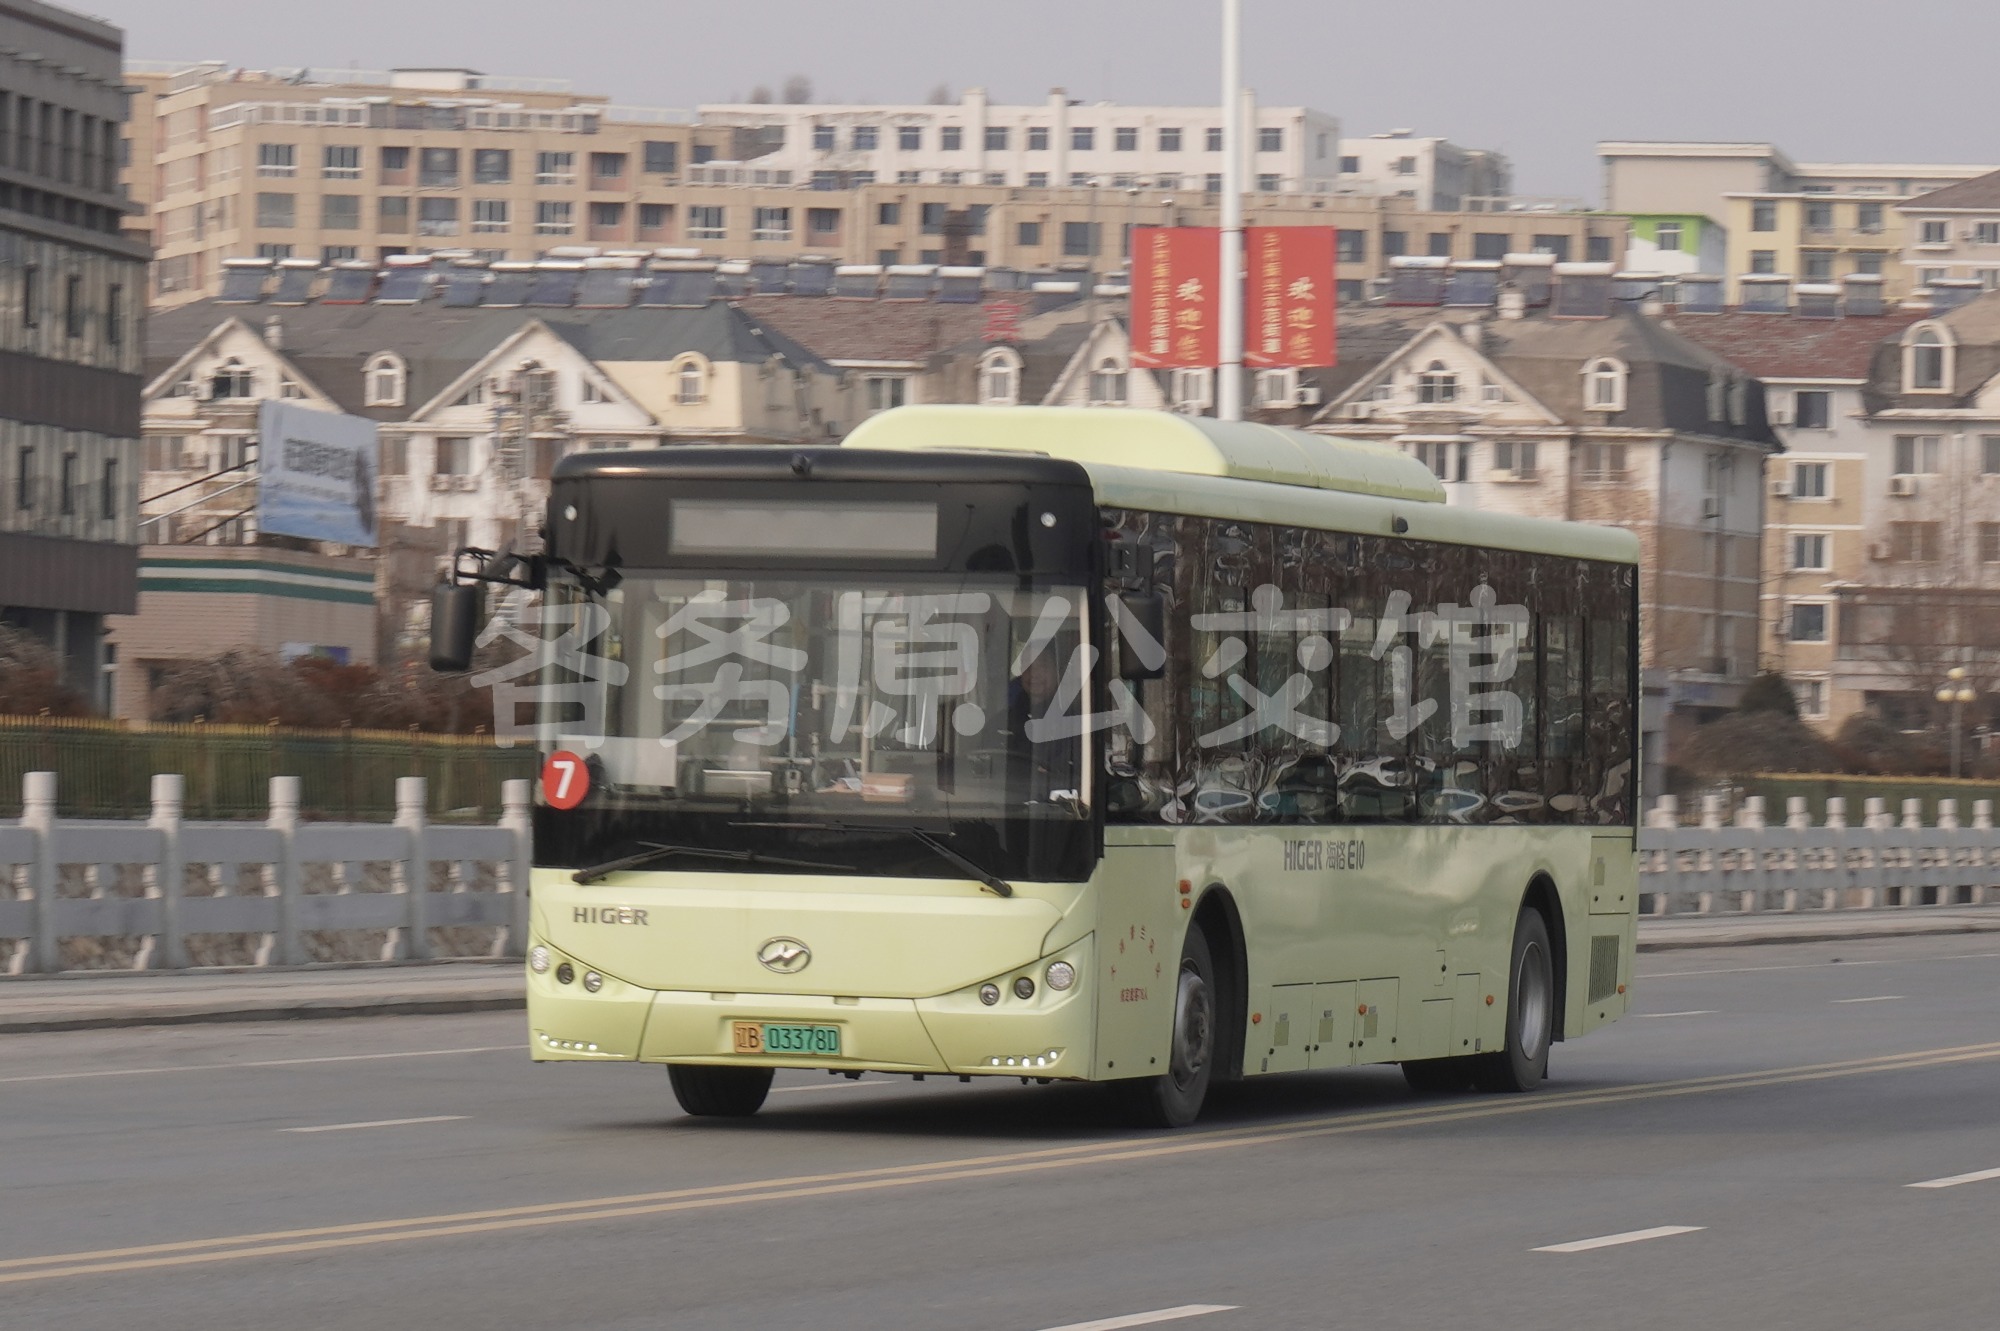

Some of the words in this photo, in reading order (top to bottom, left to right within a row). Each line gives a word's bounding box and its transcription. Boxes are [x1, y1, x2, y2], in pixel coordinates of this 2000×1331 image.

[552, 760, 576, 799] 7
[1283, 840, 1323, 871] HIGER
[1326, 840, 1346, 870] 海格
[1347, 840, 1365, 870] E10
[572, 905, 649, 926] HIGER
[769, 1028, 838, 1051] 03378D
